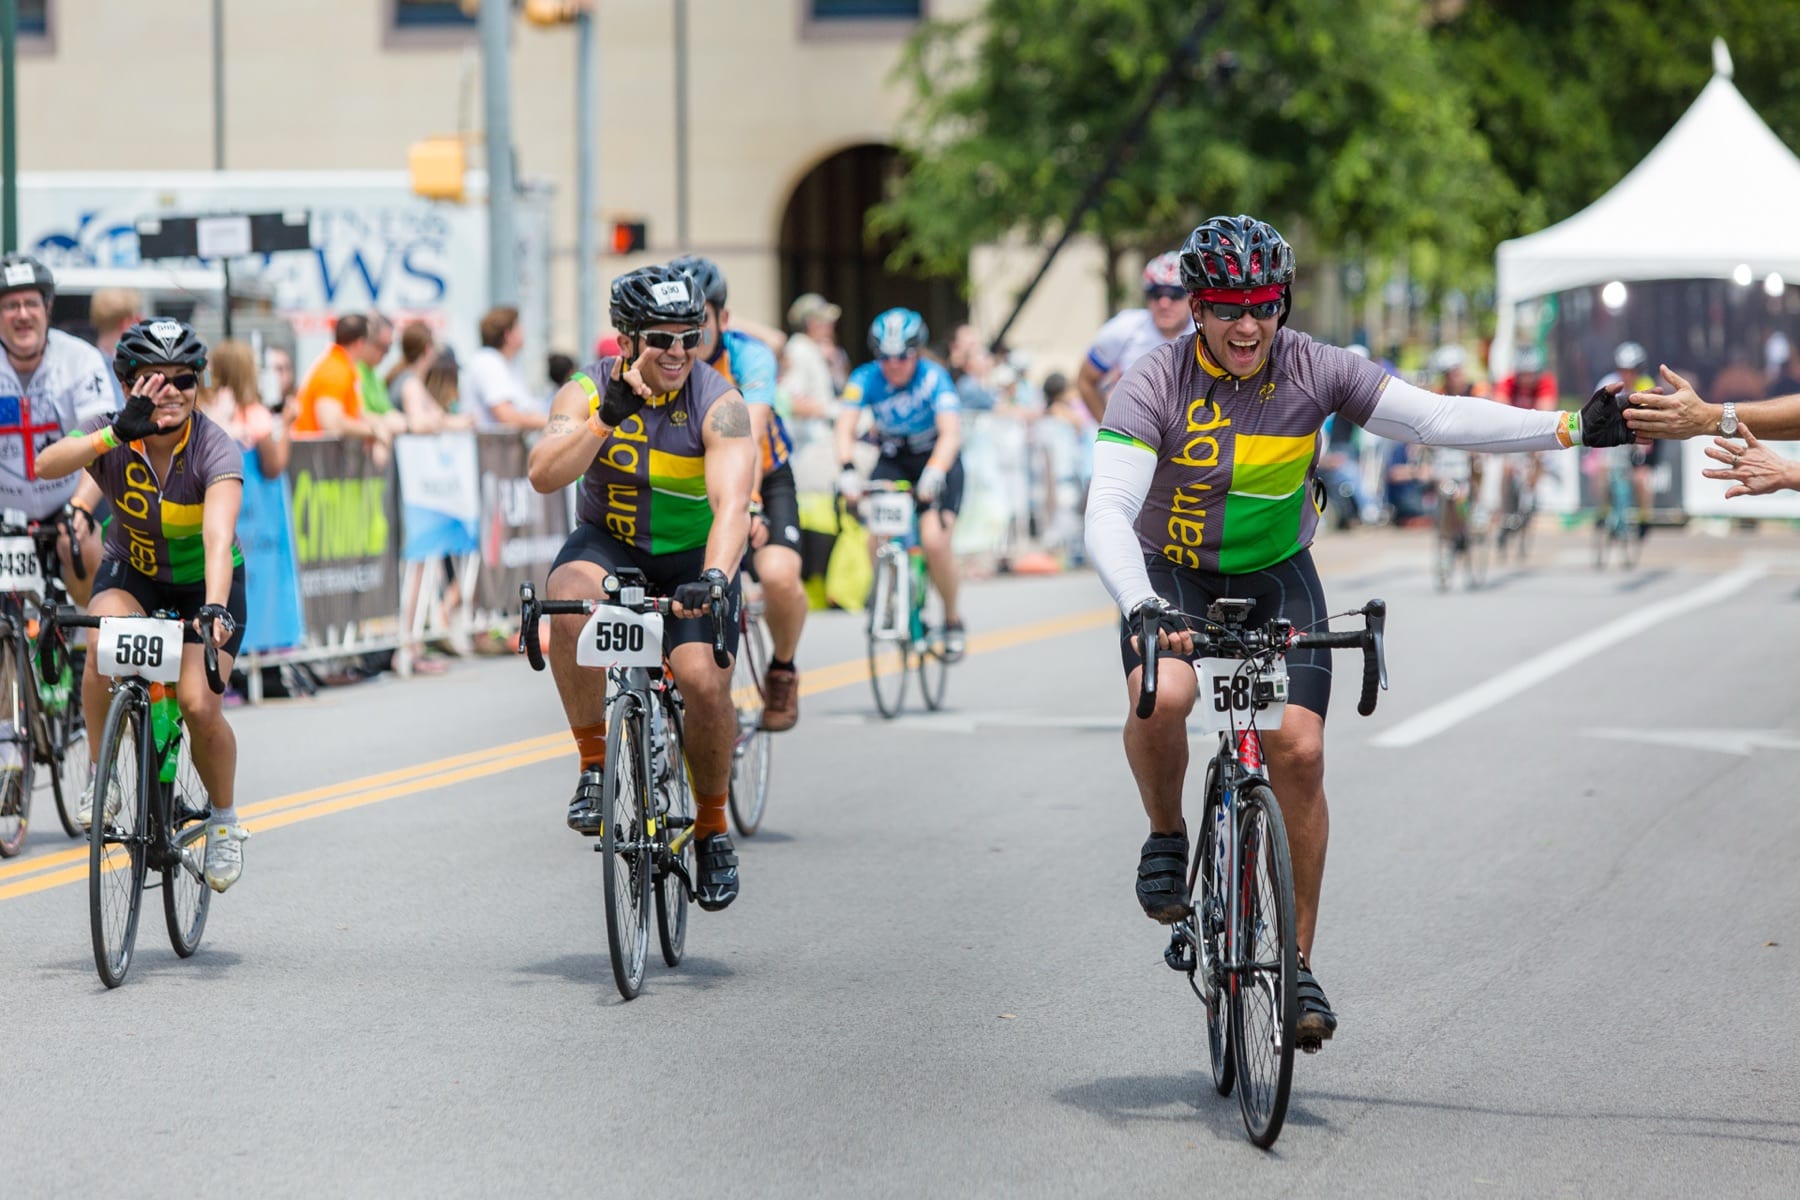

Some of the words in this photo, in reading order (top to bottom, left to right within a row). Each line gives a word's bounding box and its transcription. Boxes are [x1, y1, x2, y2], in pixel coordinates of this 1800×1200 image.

[599, 413, 648, 474] bp
[1170, 398, 1231, 467] bp
[115, 461, 158, 520] bp
[115, 634, 163, 668] 589
[595, 621, 644, 652] 590
